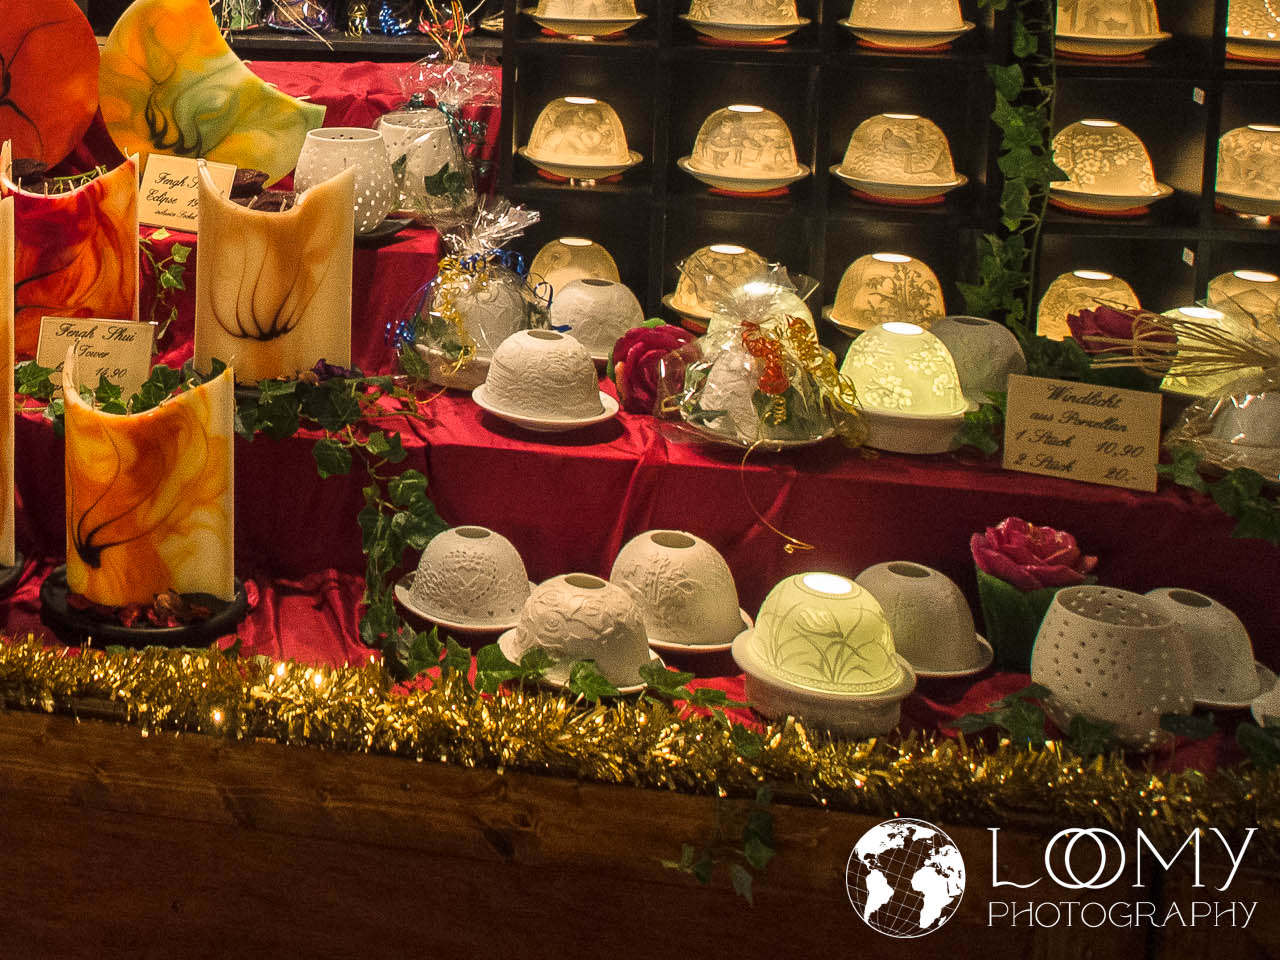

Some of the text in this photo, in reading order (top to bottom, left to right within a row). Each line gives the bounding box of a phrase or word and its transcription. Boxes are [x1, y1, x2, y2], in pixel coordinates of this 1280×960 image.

[154, 171, 190, 190] Fengh
[146, 188, 179, 207] Eclipse
[101, 325, 138, 342] Shui
[77, 344, 110, 359] Tower
[1047, 384, 1123, 409] Windlicht
[1029, 410, 1129, 433] aus Porzellan
[1014, 429, 1145, 459] 1 Stück 10,90
[1013, 453, 1028, 465] 2
[1030, 453, 1077, 472] Stück
